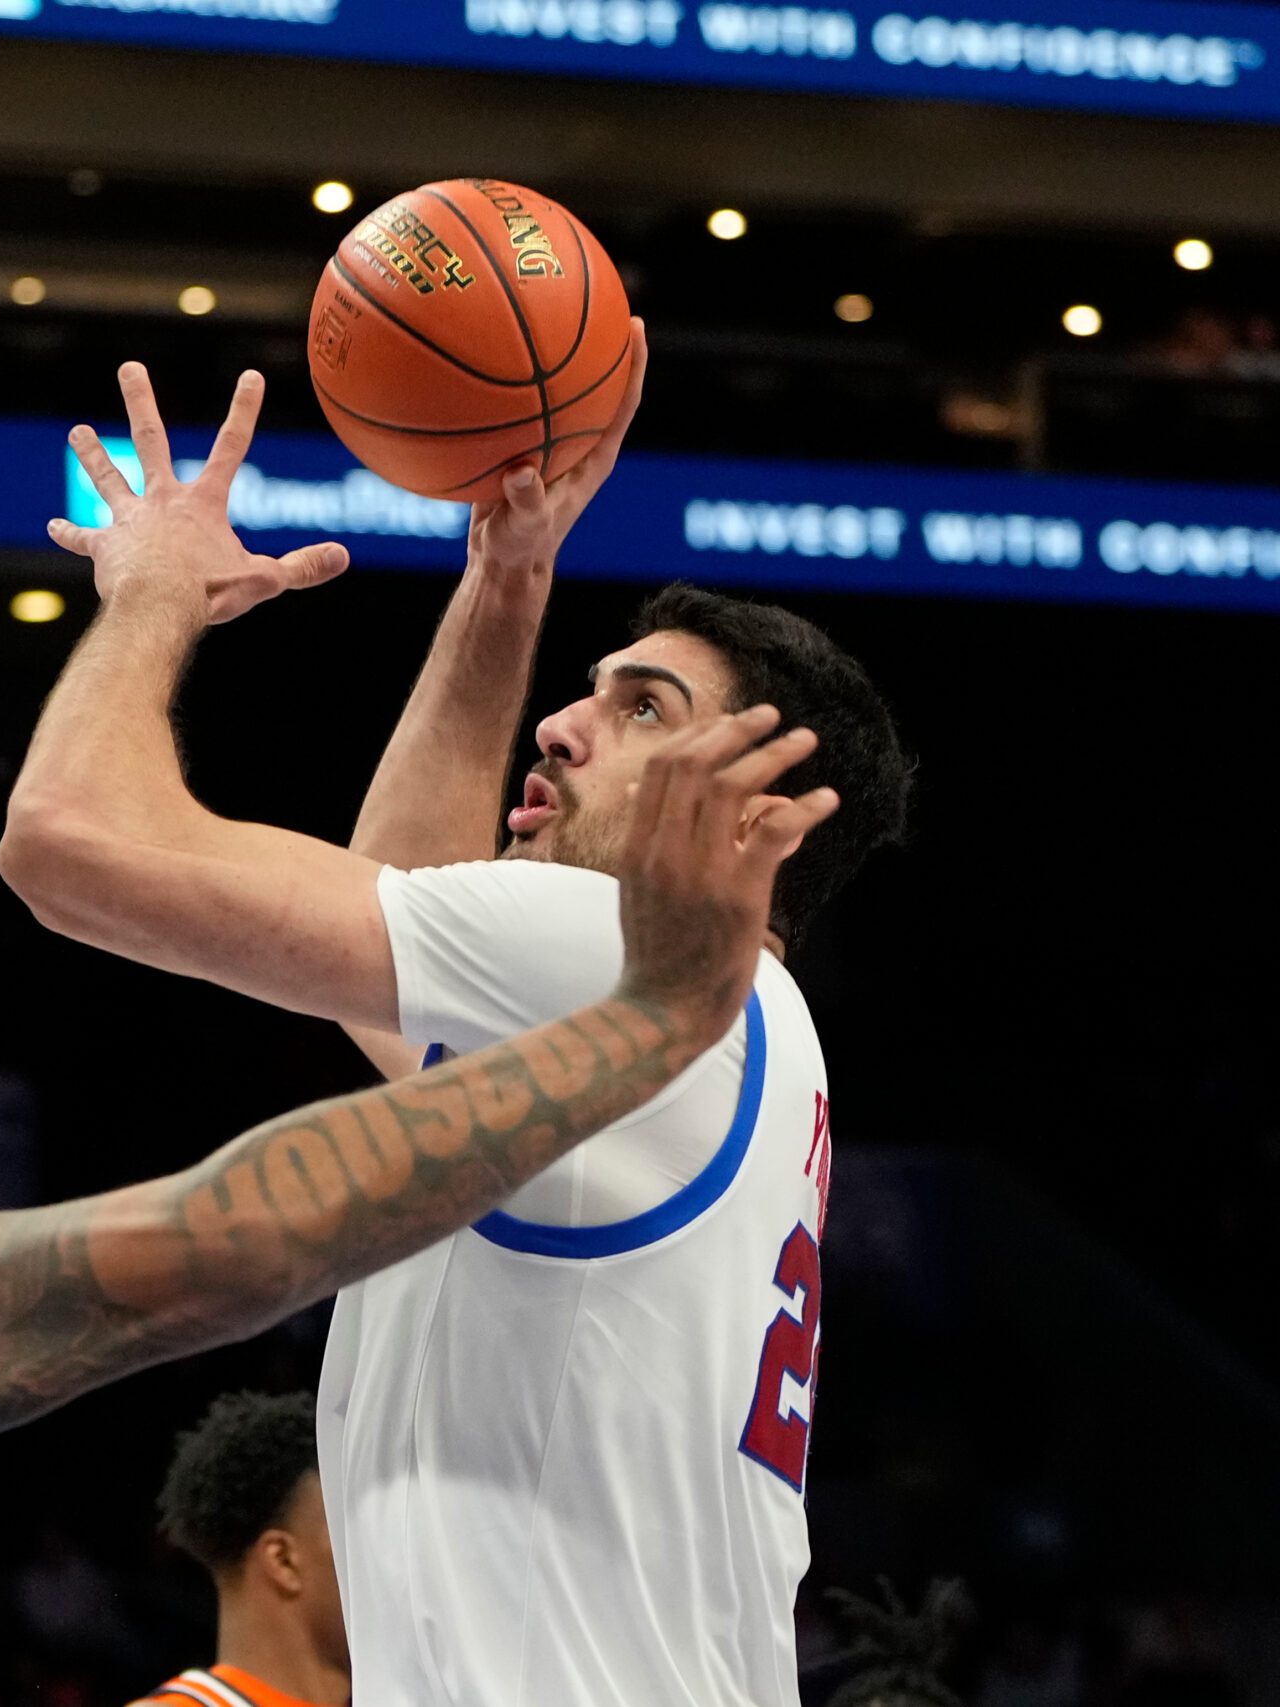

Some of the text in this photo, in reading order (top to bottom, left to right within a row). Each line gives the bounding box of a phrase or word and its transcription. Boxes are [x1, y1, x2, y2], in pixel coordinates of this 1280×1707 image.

[699, 4, 857, 60] WITH
[872, 13, 1240, 88] CONFIDENCE
[685, 500, 904, 559] INVEST
[923, 513, 1083, 569] WITH
[738, 1218, 821, 1494] 2
